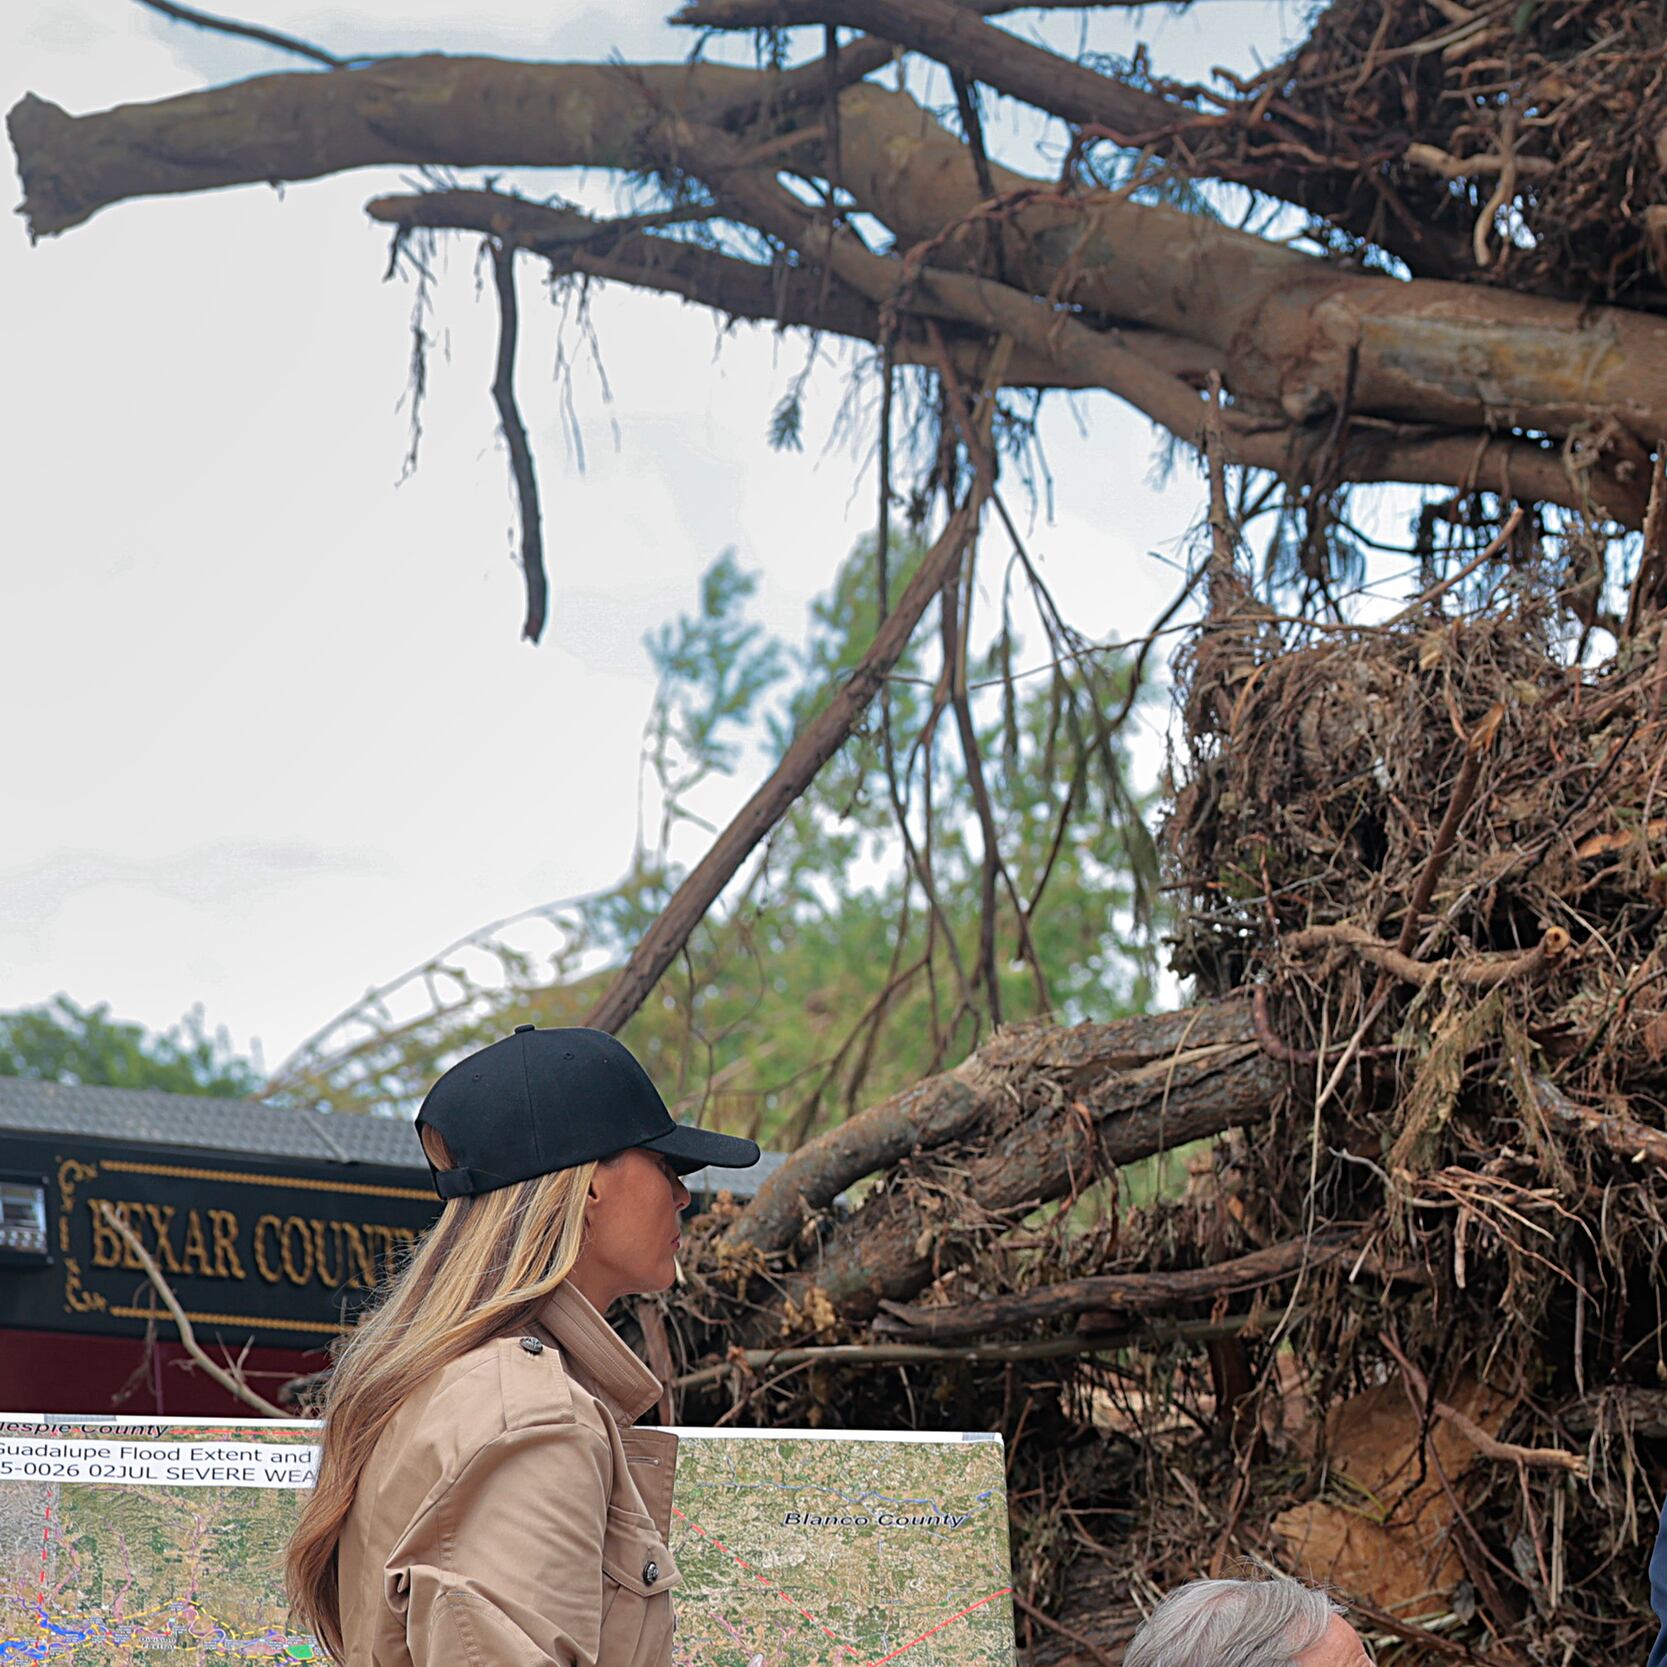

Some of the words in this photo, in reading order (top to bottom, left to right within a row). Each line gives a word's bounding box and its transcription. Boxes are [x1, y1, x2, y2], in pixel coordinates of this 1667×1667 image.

[88, 1198, 246, 1281] BEXAR
[254, 1213, 420, 1289] COUNT
[81, 1423, 169, 1439] County
[120, 1446, 180, 1461] Flood
[190, 1447, 262, 1462] Extent
[270, 1450, 311, 1463] and
[0, 1461, 80, 1477] 5-0026
[89, 1463, 157, 1479] 02JUL
[166, 1466, 256, 1481] SEVERE
[783, 1512, 869, 1526] Blanco
[877, 1513, 965, 1528] County
